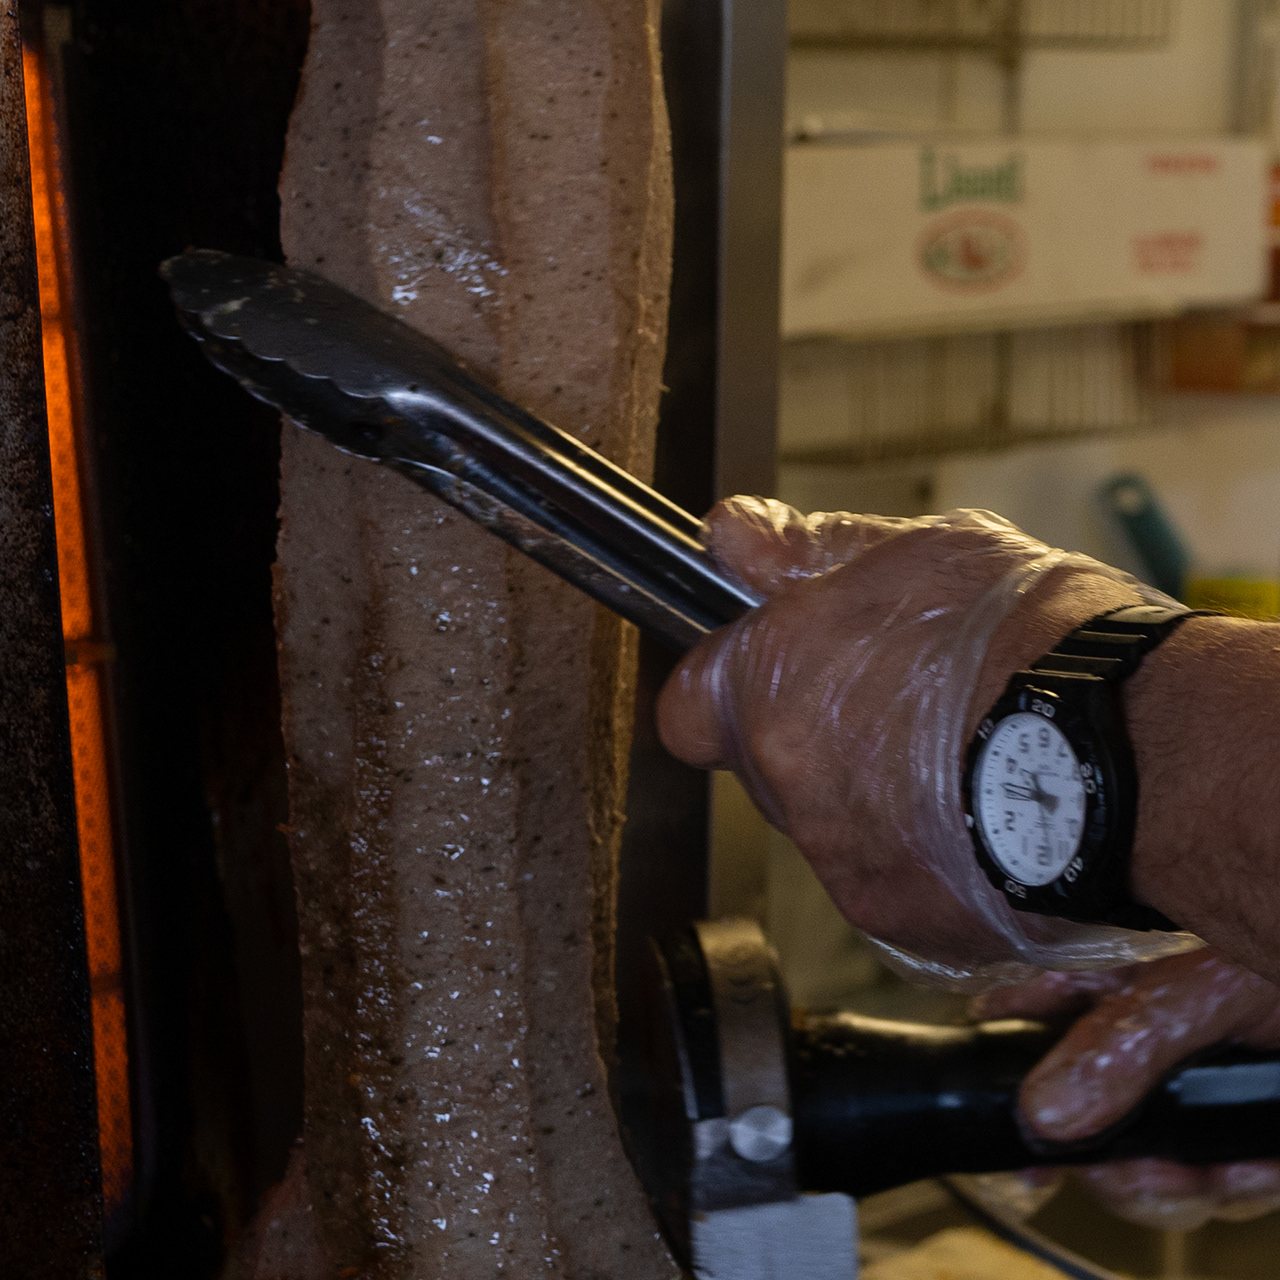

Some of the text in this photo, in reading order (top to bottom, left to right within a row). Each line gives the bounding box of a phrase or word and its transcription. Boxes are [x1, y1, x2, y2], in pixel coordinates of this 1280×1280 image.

[1031, 698, 1056, 718] 20
[1063, 856, 1084, 883] 40
[1004, 879, 1028, 899] 50
